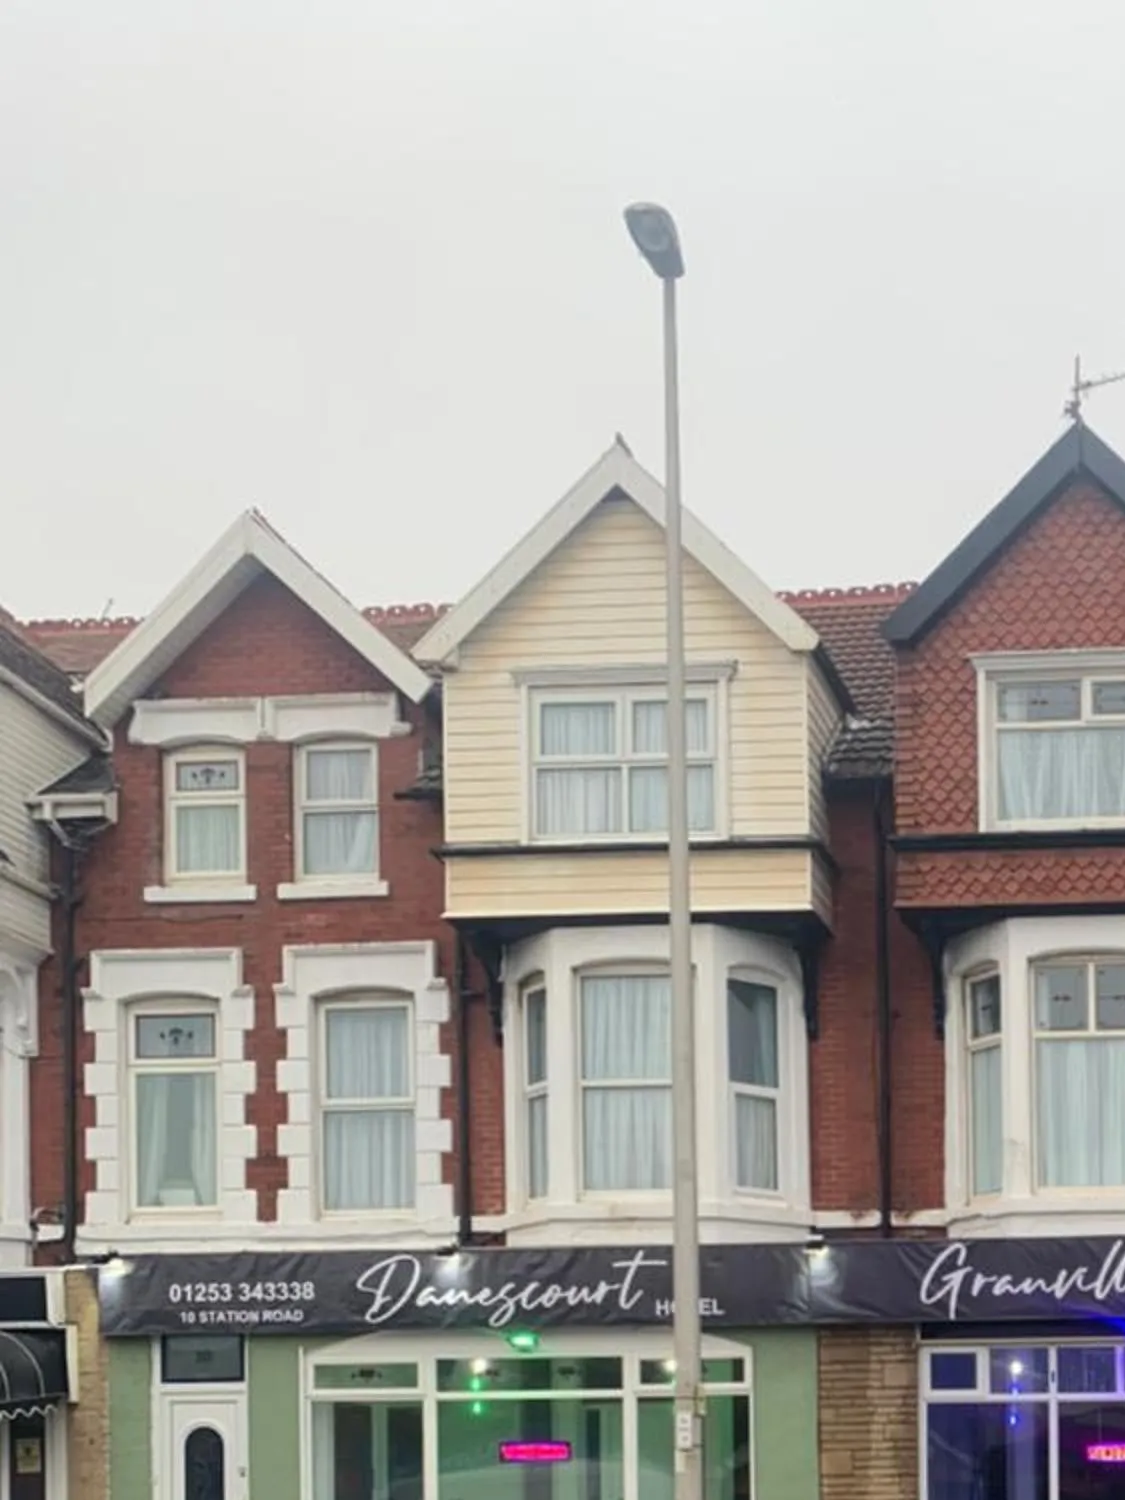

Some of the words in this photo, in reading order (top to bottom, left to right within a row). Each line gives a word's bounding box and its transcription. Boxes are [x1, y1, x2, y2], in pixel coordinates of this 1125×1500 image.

[169, 1283, 232, 1302] 01253
[238, 1281, 315, 1301] 343338
[356, 1250, 668, 1327] Danescourt
[655, 1298, 725, 1317] HEL
[198, 1310, 259, 1324] STATION
[262, 1309, 304, 1323] ROAD
